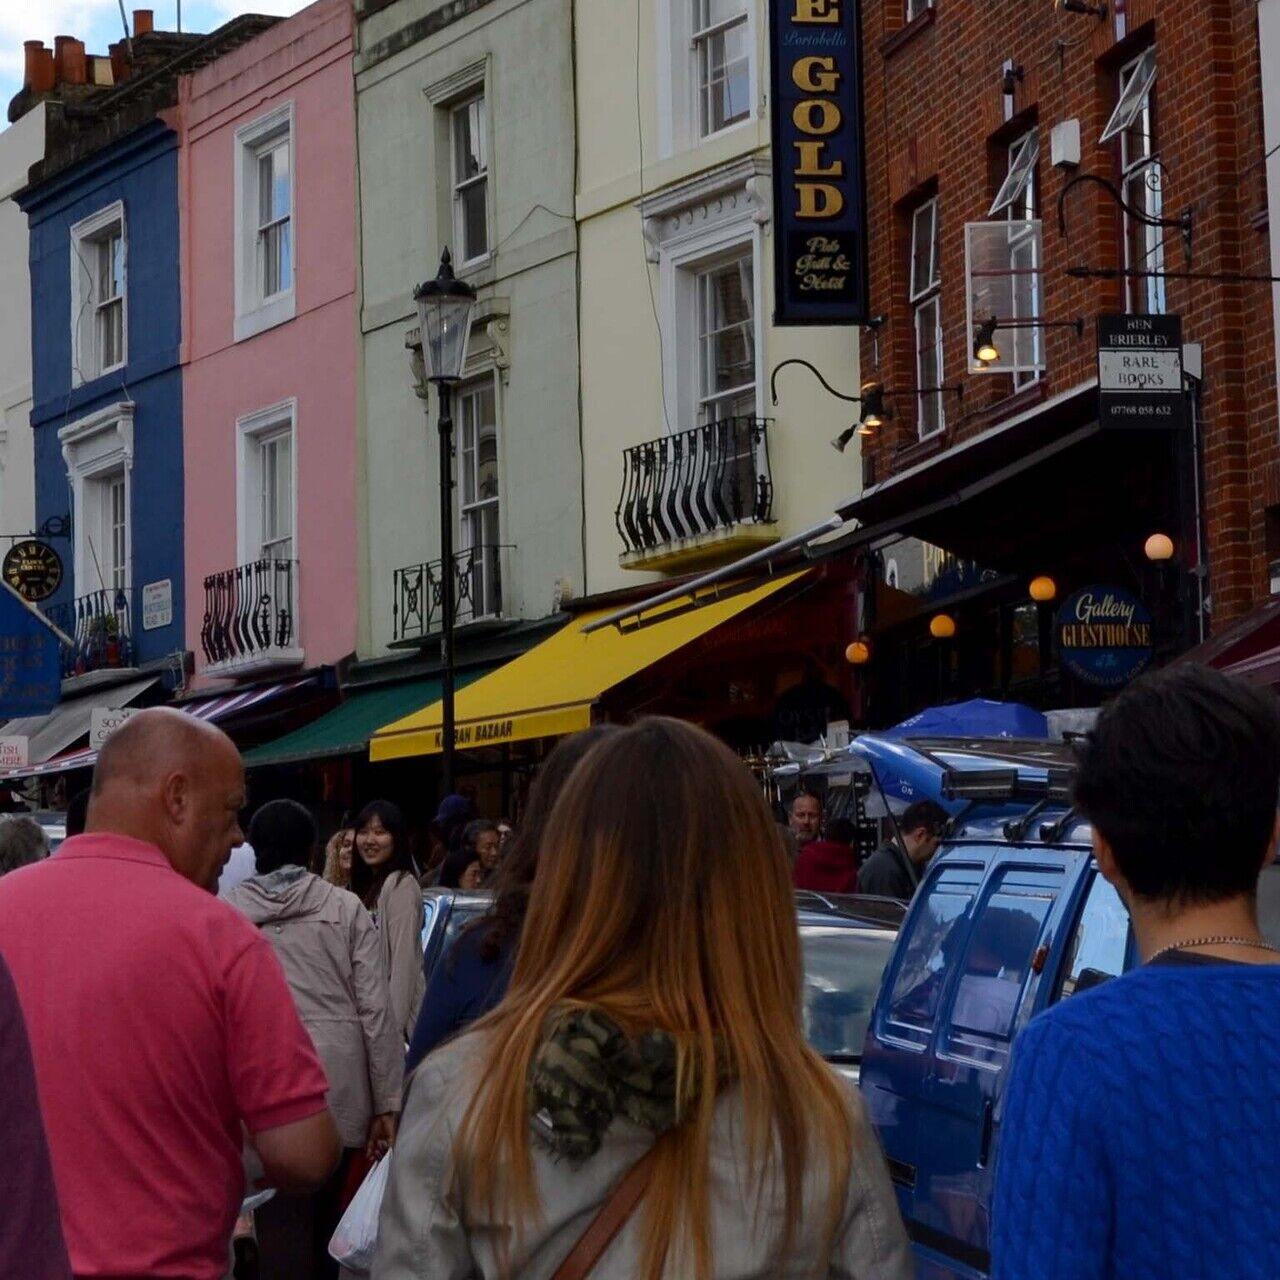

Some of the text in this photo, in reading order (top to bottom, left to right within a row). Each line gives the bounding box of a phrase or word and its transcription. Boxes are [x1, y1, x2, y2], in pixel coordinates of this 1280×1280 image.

[792, 56, 843, 217] GOLD
[806, 236, 840, 253] Pub
[795, 254, 851, 275] Grill &
[800, 274, 846, 290] Hotel
[1109, 334, 1169, 346] BRIERLEY
[1123, 356, 1159, 369] RARE
[1118, 373, 1164, 387] BOOKS
[1075, 593, 1135, 628] Gallery
[1062, 623, 1151, 647] GUESTHOUSE
[475, 720, 513, 741] BAZAAR
